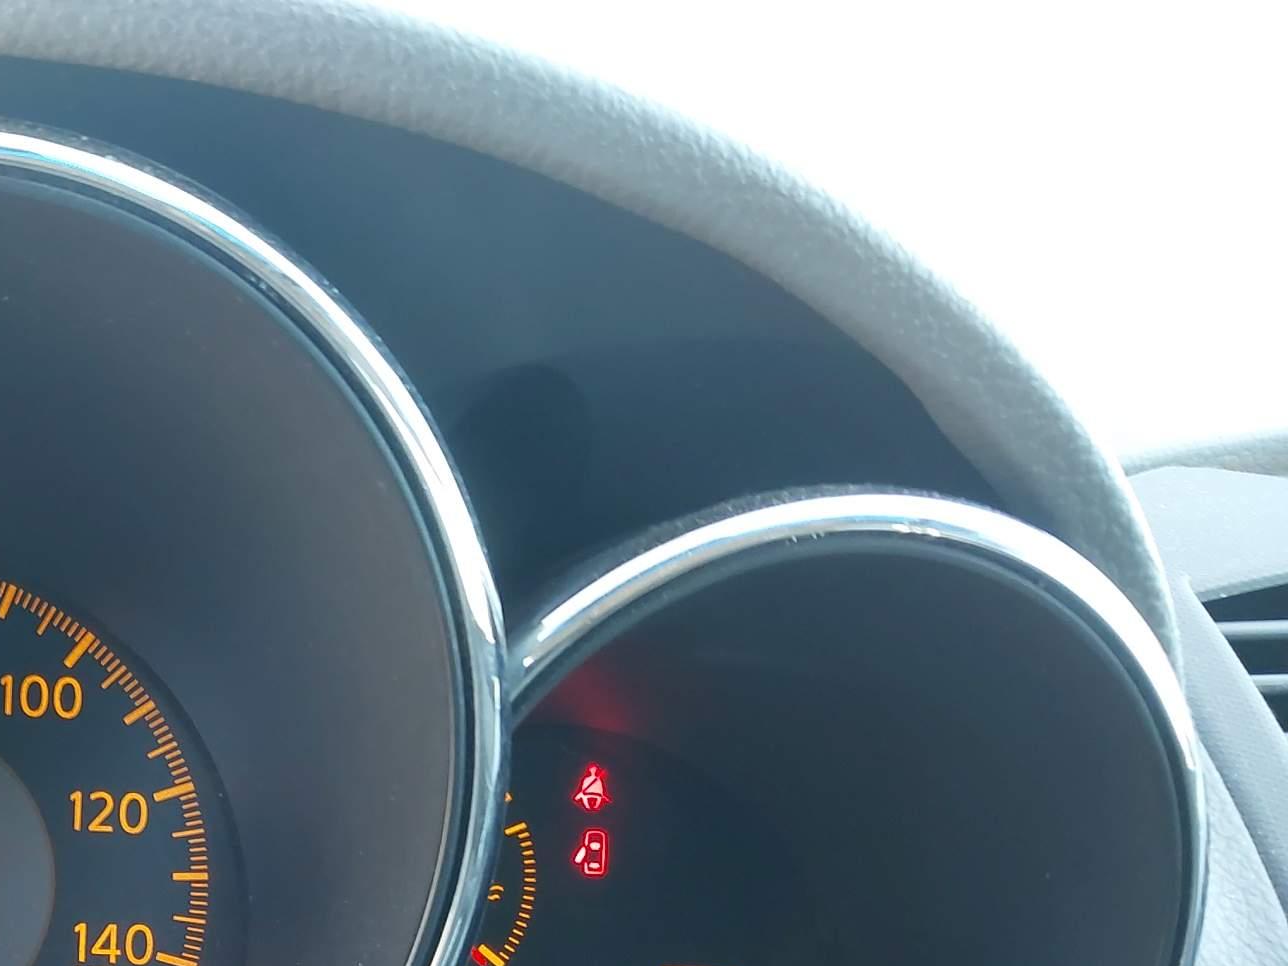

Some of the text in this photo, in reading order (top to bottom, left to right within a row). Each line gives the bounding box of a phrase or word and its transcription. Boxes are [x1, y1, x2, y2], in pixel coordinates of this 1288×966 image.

[1, 675, 83, 719] 100
[70, 791, 148, 834] 120
[73, 922, 154, 965] 140
